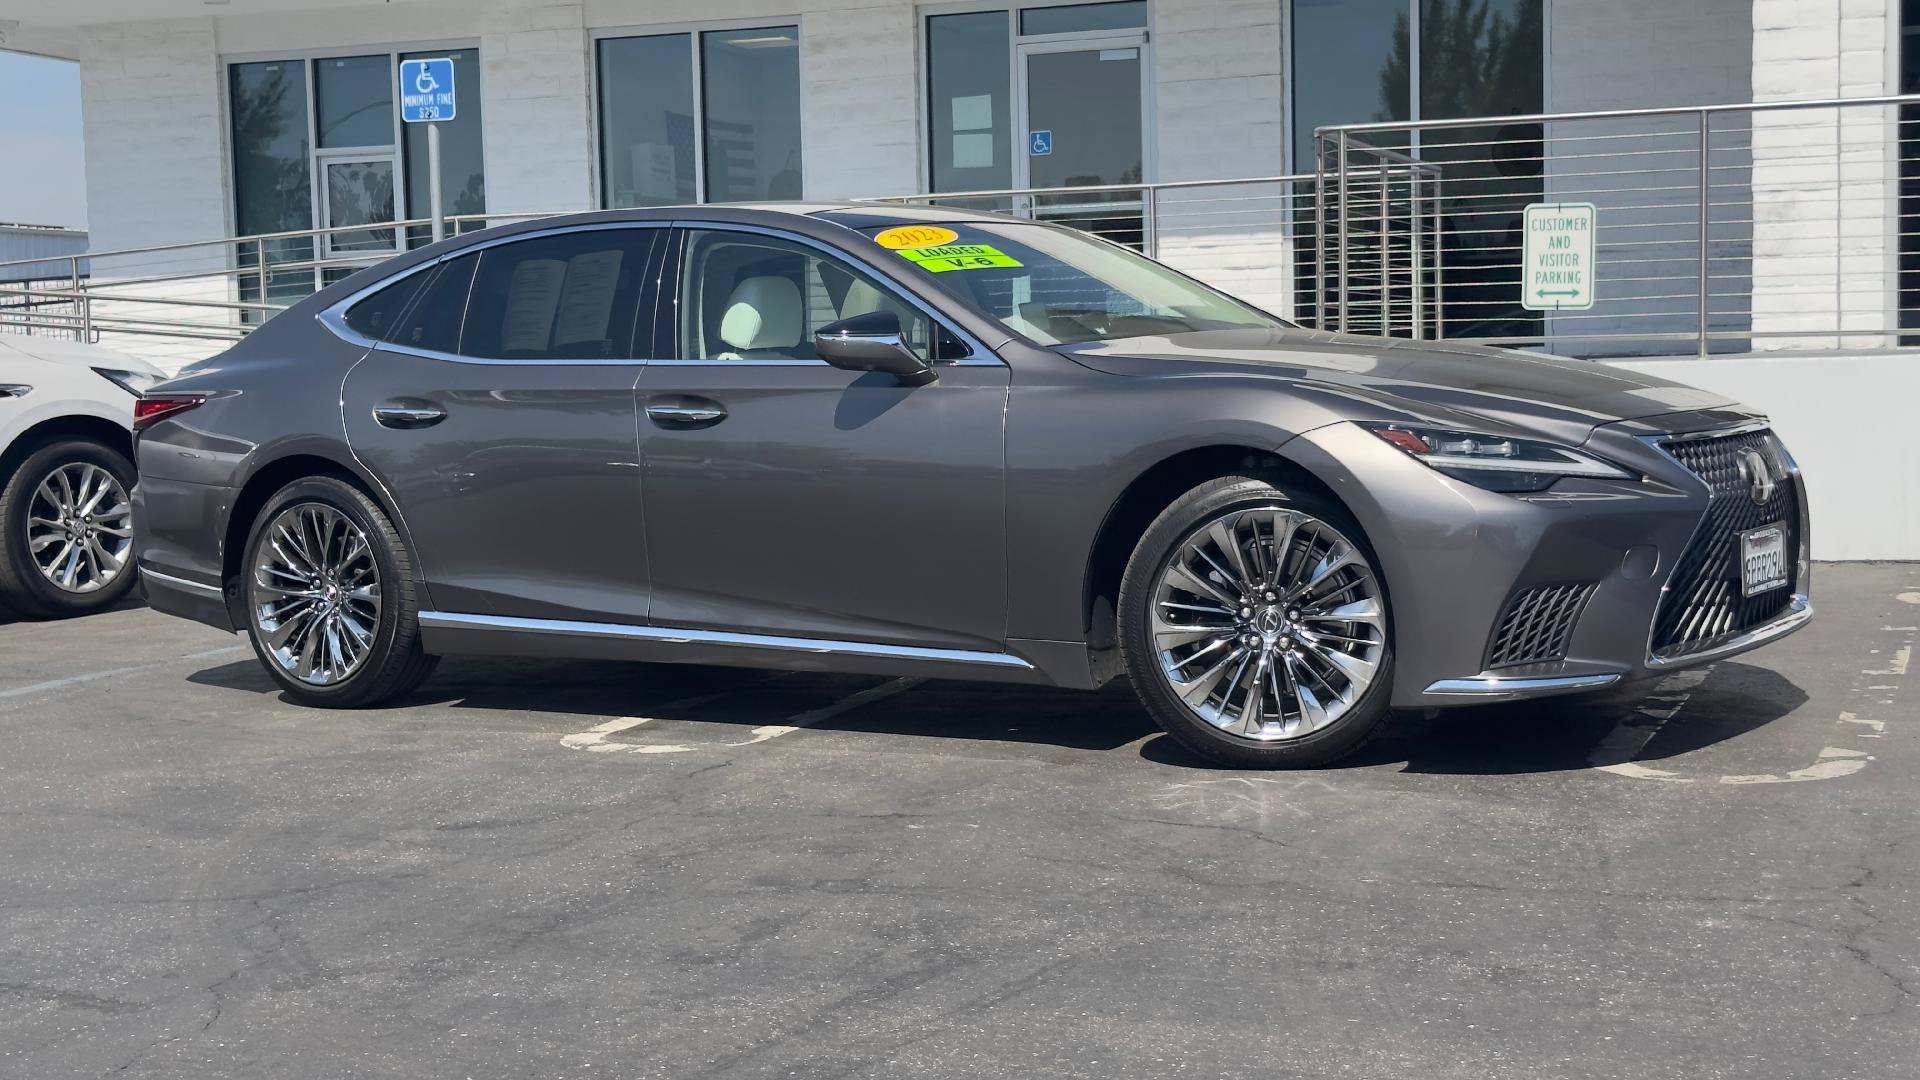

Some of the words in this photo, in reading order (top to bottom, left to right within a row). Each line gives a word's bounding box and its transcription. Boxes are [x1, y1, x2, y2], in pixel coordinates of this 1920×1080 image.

[405, 93, 434, 107] MINIMUM
[436, 92, 452, 105] FINE
[419, 106, 439, 118] $250
[1531, 217, 1588, 232] CUSTOMER
[890, 228, 943, 246] 2023
[1548, 235, 1571, 249] AND
[915, 246, 986, 258] LOADED
[946, 257, 994, 267] V-6
[1538, 253, 1579, 267] VISITOR
[1535, 271, 1581, 284] PARKING
